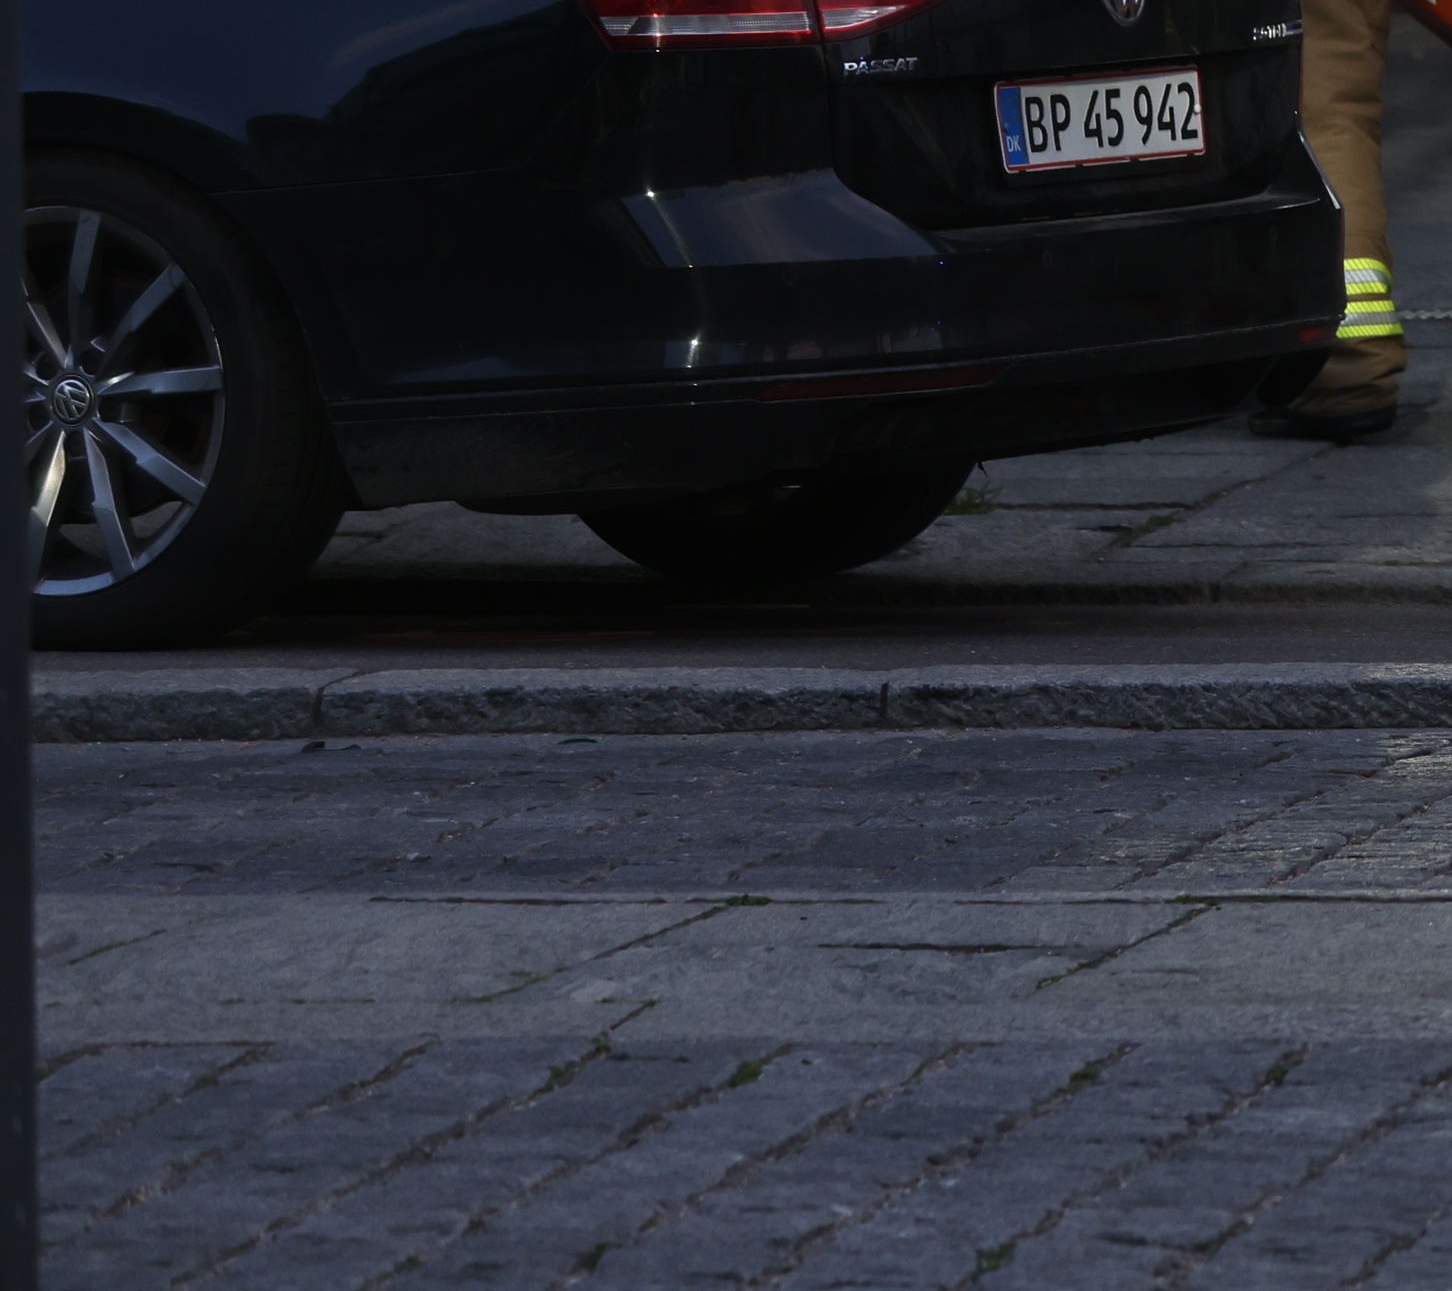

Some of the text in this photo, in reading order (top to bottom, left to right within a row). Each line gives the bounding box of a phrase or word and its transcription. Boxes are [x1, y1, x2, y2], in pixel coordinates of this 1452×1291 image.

[843, 56, 918, 76] PASSAT
[1024, 82, 1198, 154] BP 45 942
[1006, 135, 1021, 153] DK
